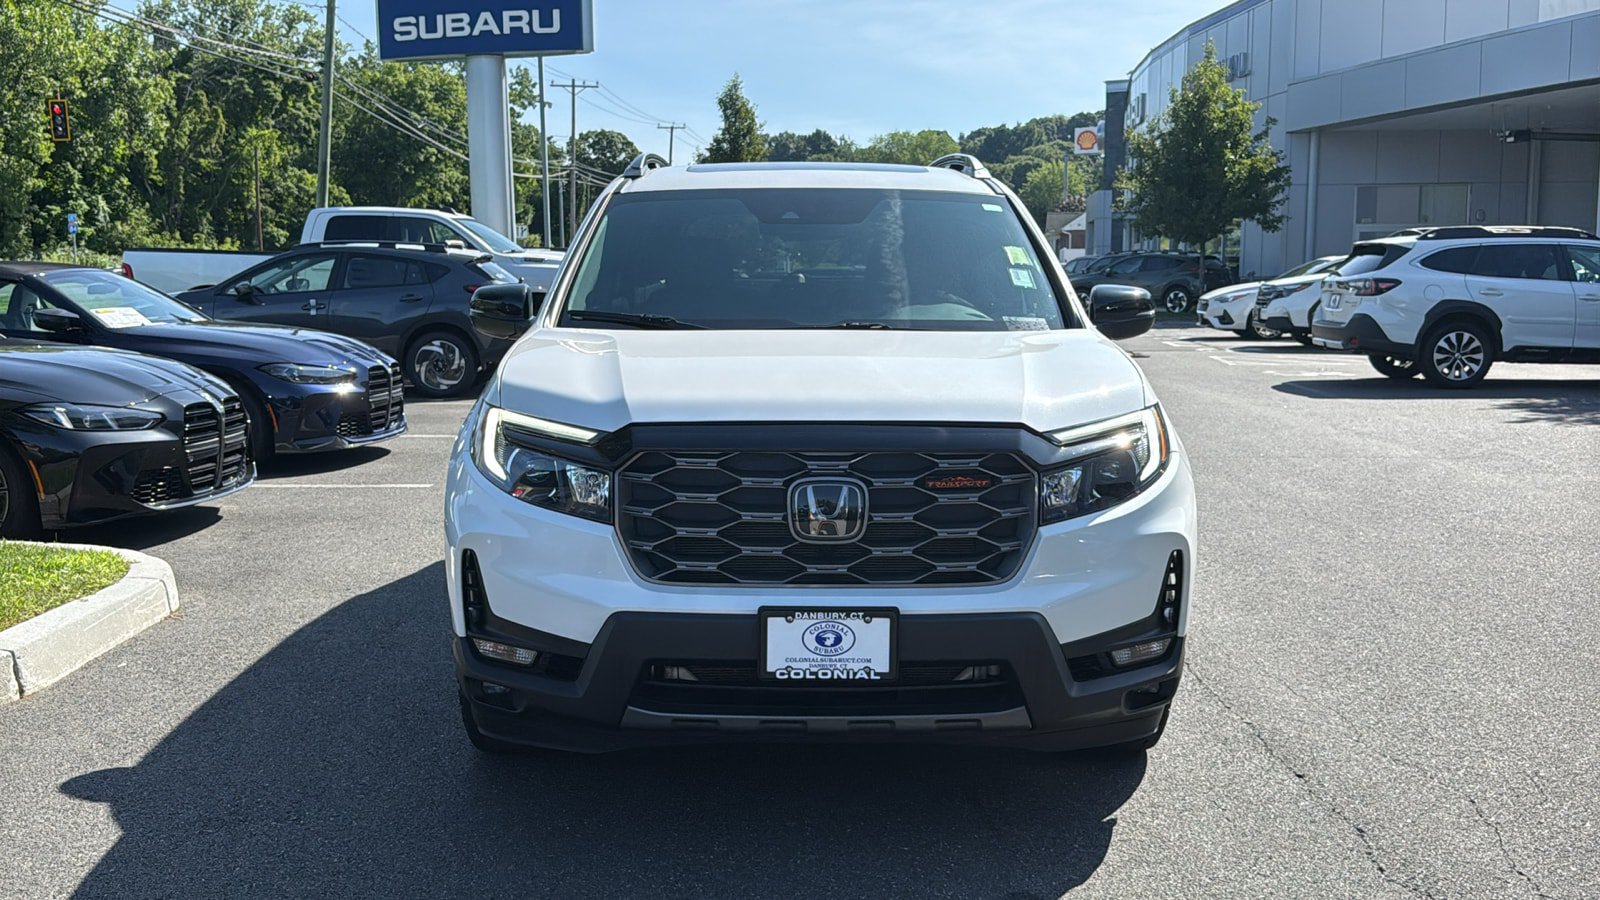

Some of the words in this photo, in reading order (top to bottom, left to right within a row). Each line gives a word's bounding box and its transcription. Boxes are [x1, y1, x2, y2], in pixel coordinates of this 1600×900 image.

[393, 8, 561, 42] SUBARU
[927, 480, 989, 488] TRAILSPORT
[795, 611, 847, 620] DANBURY,
[850, 611, 865, 620] CT
[808, 623, 850, 637] COLONIAL
[813, 645, 845, 655] SUBARU
[775, 668, 881, 680] COLONIAL
